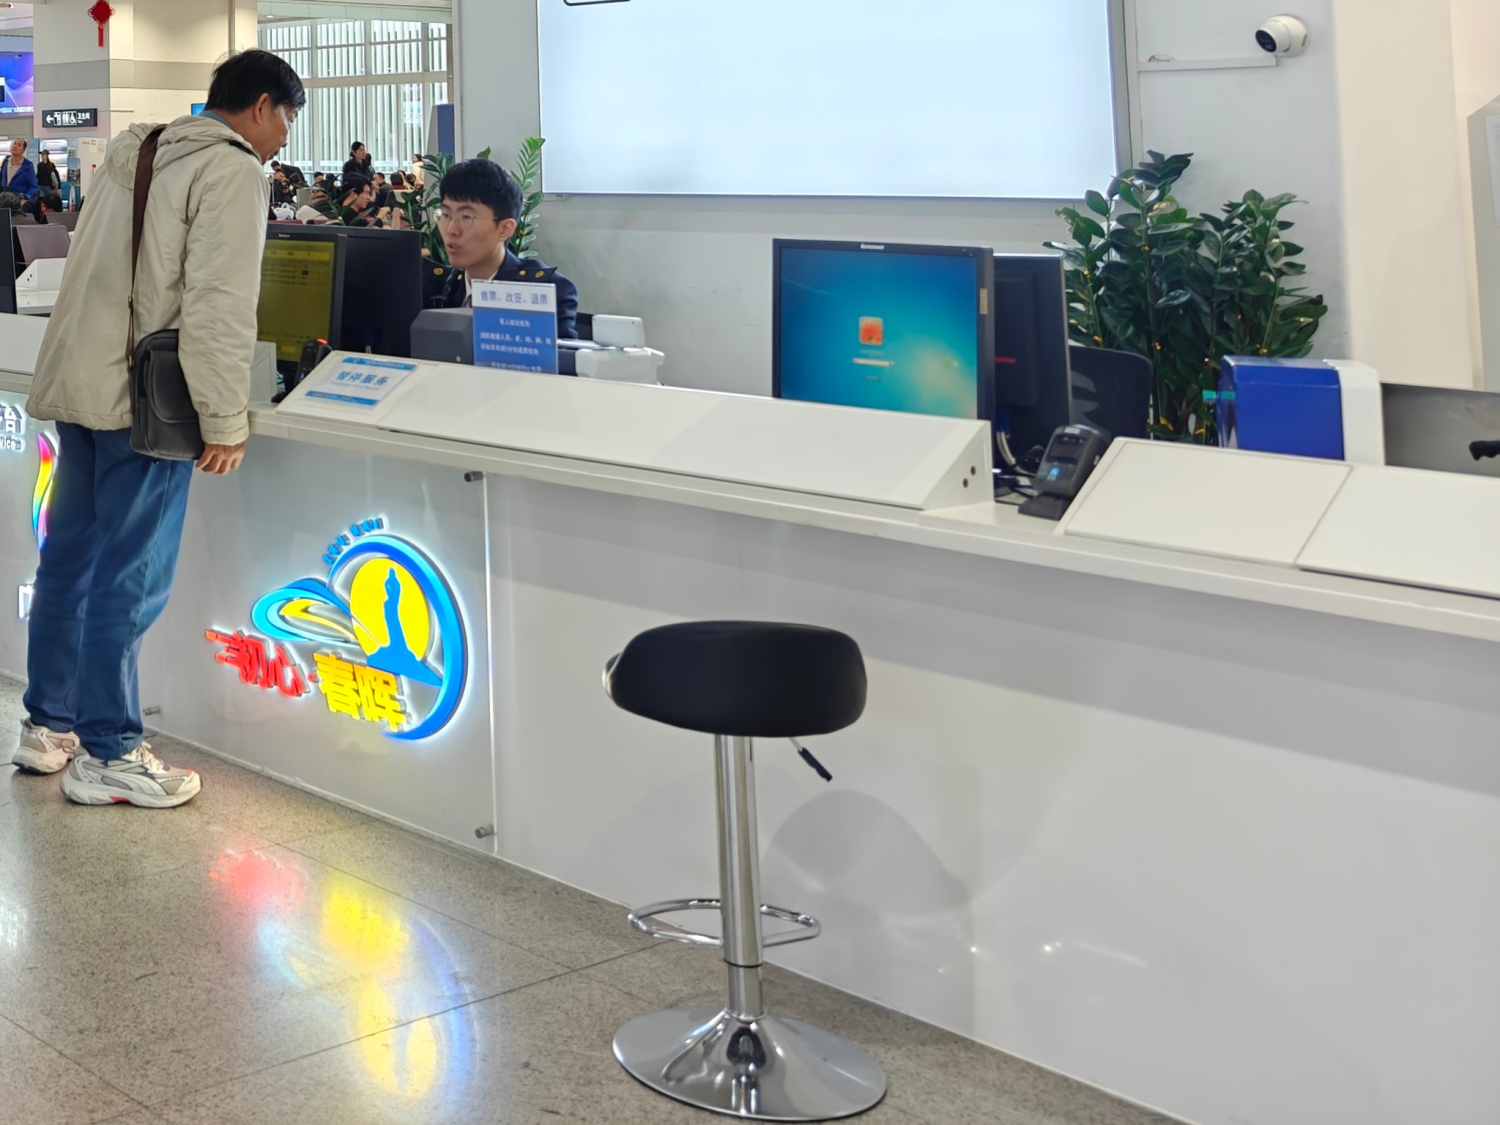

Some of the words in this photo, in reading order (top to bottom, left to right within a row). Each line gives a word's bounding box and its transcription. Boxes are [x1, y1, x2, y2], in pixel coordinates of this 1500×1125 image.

[480, 290, 549, 305] 售票、改签、退票
